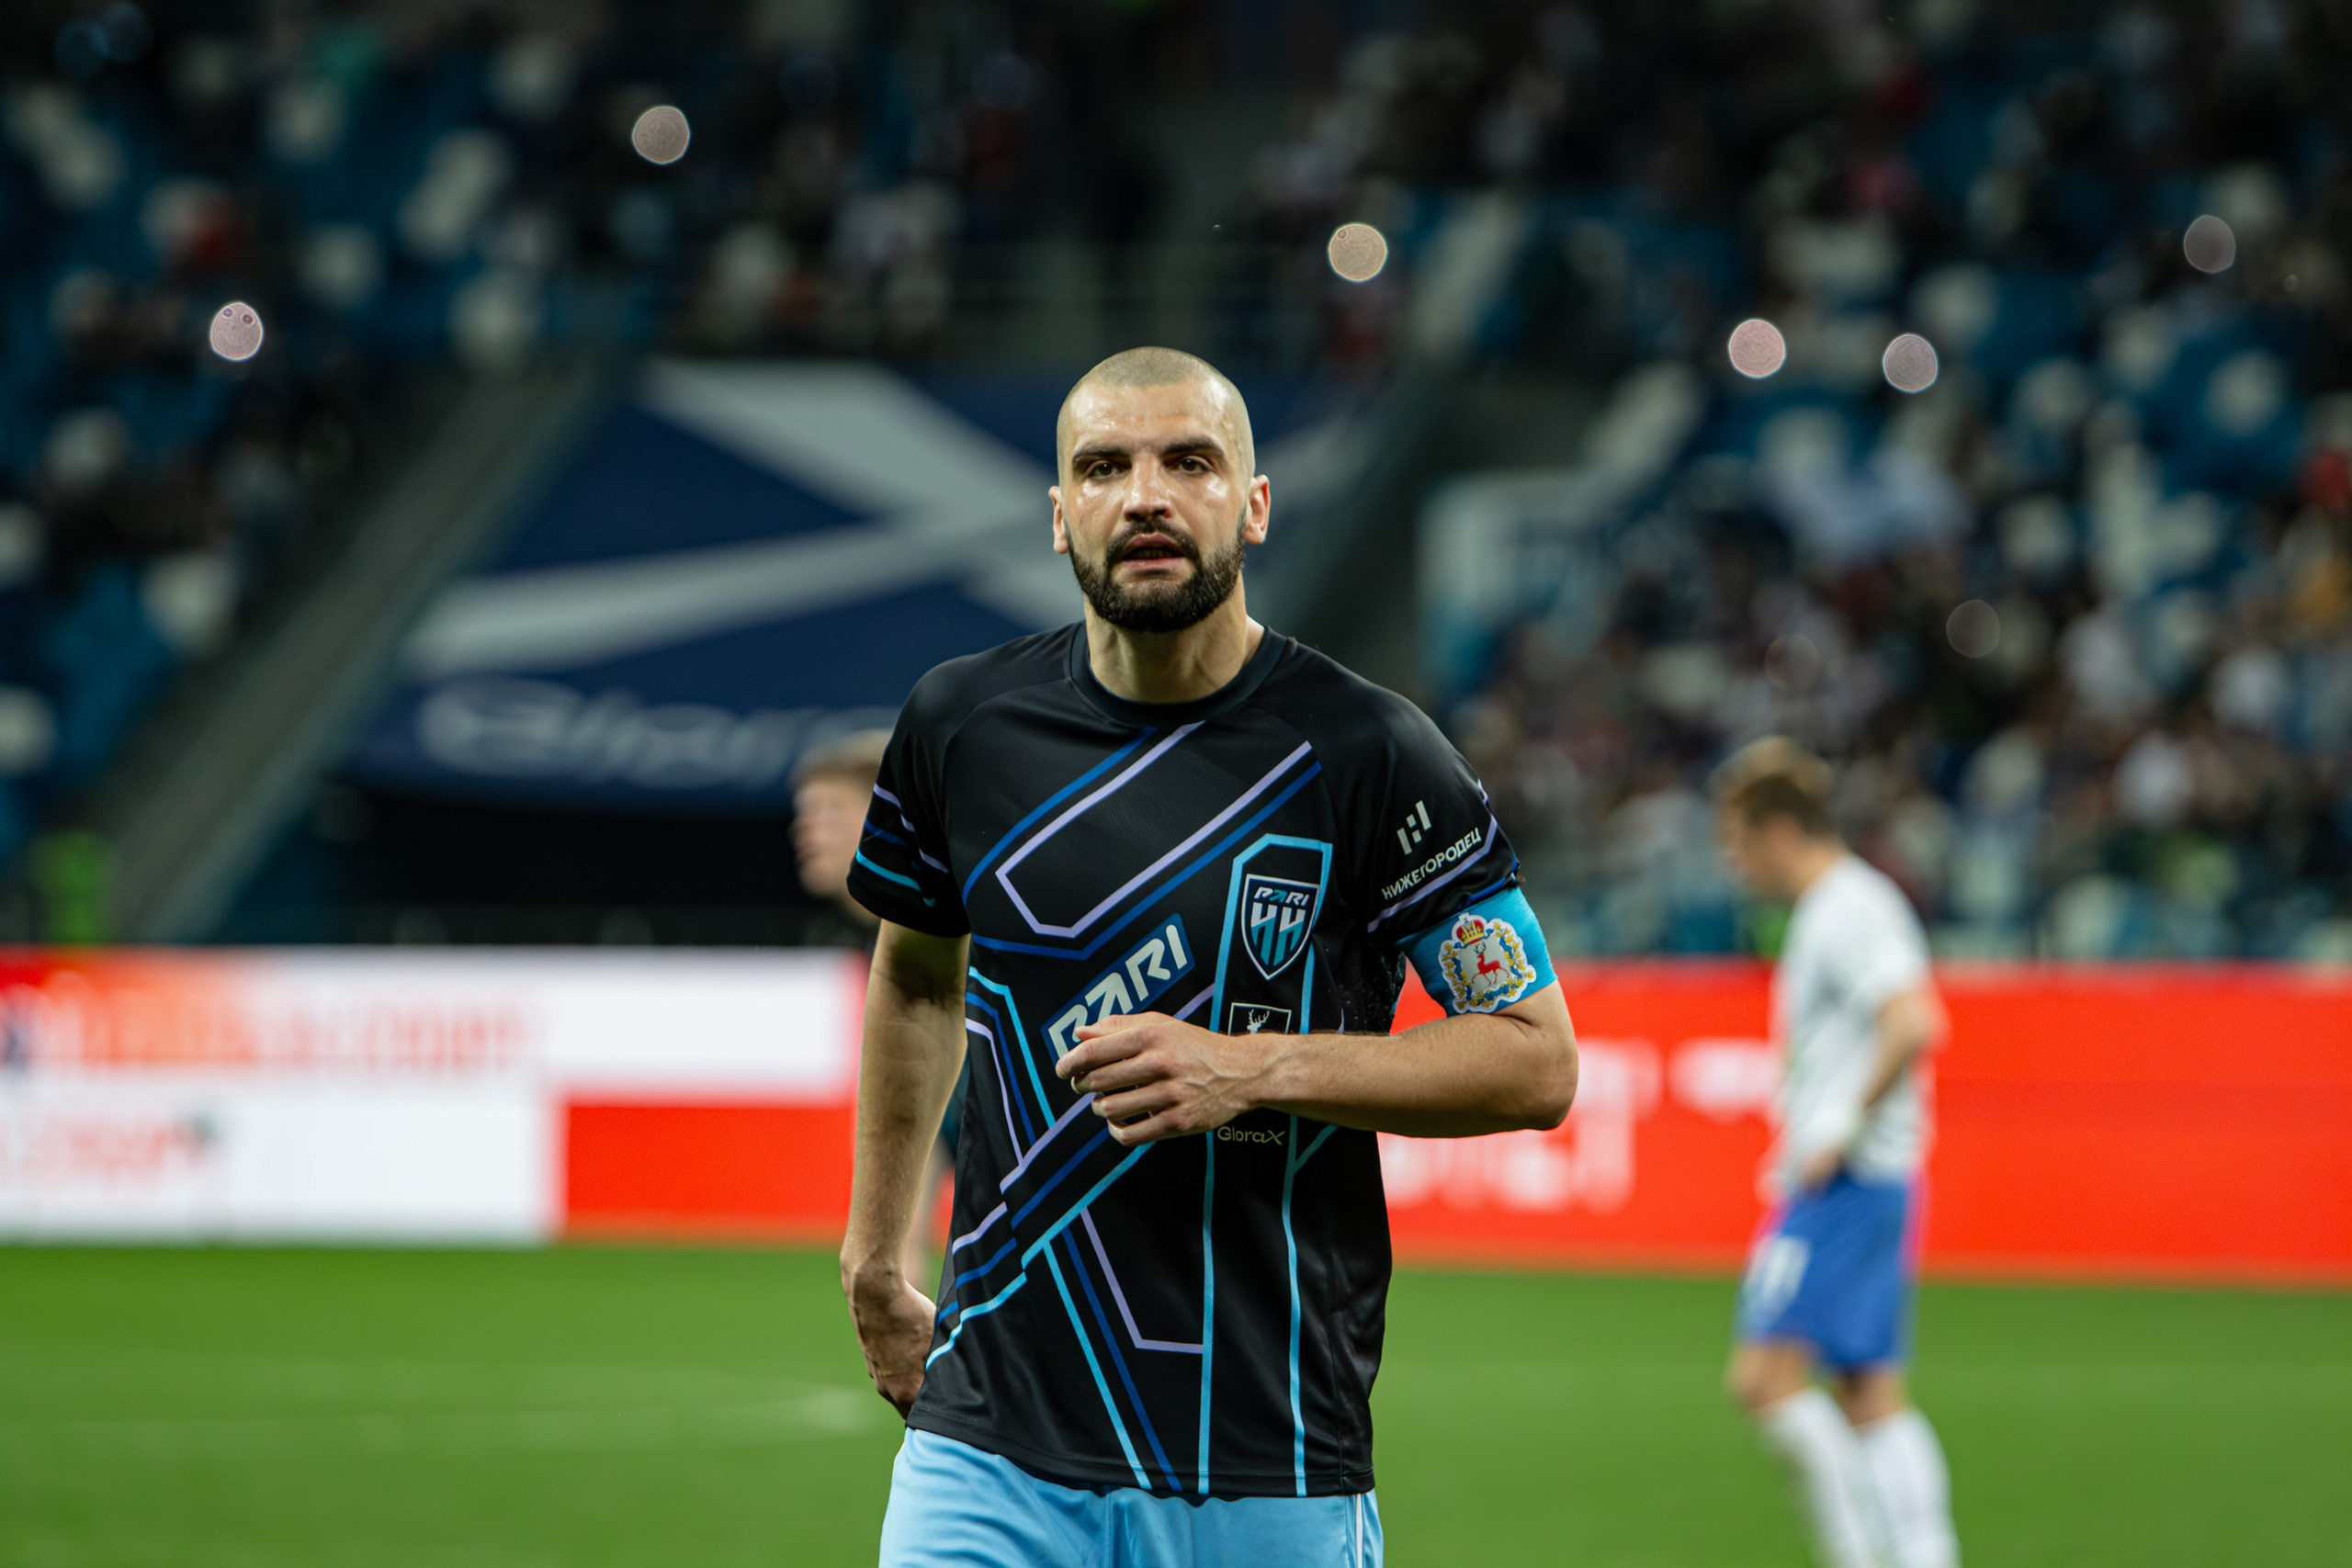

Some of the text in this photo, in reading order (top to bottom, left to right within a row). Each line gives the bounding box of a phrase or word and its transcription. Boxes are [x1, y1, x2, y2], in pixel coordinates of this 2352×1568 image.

[1381, 827, 1482, 900] НИЖЕГОРОДЕЦ
[1253, 886, 1310, 907] PARI
[1048, 924, 1188, 1058] PARI
[1217, 1126, 1286, 1145] GloraX
